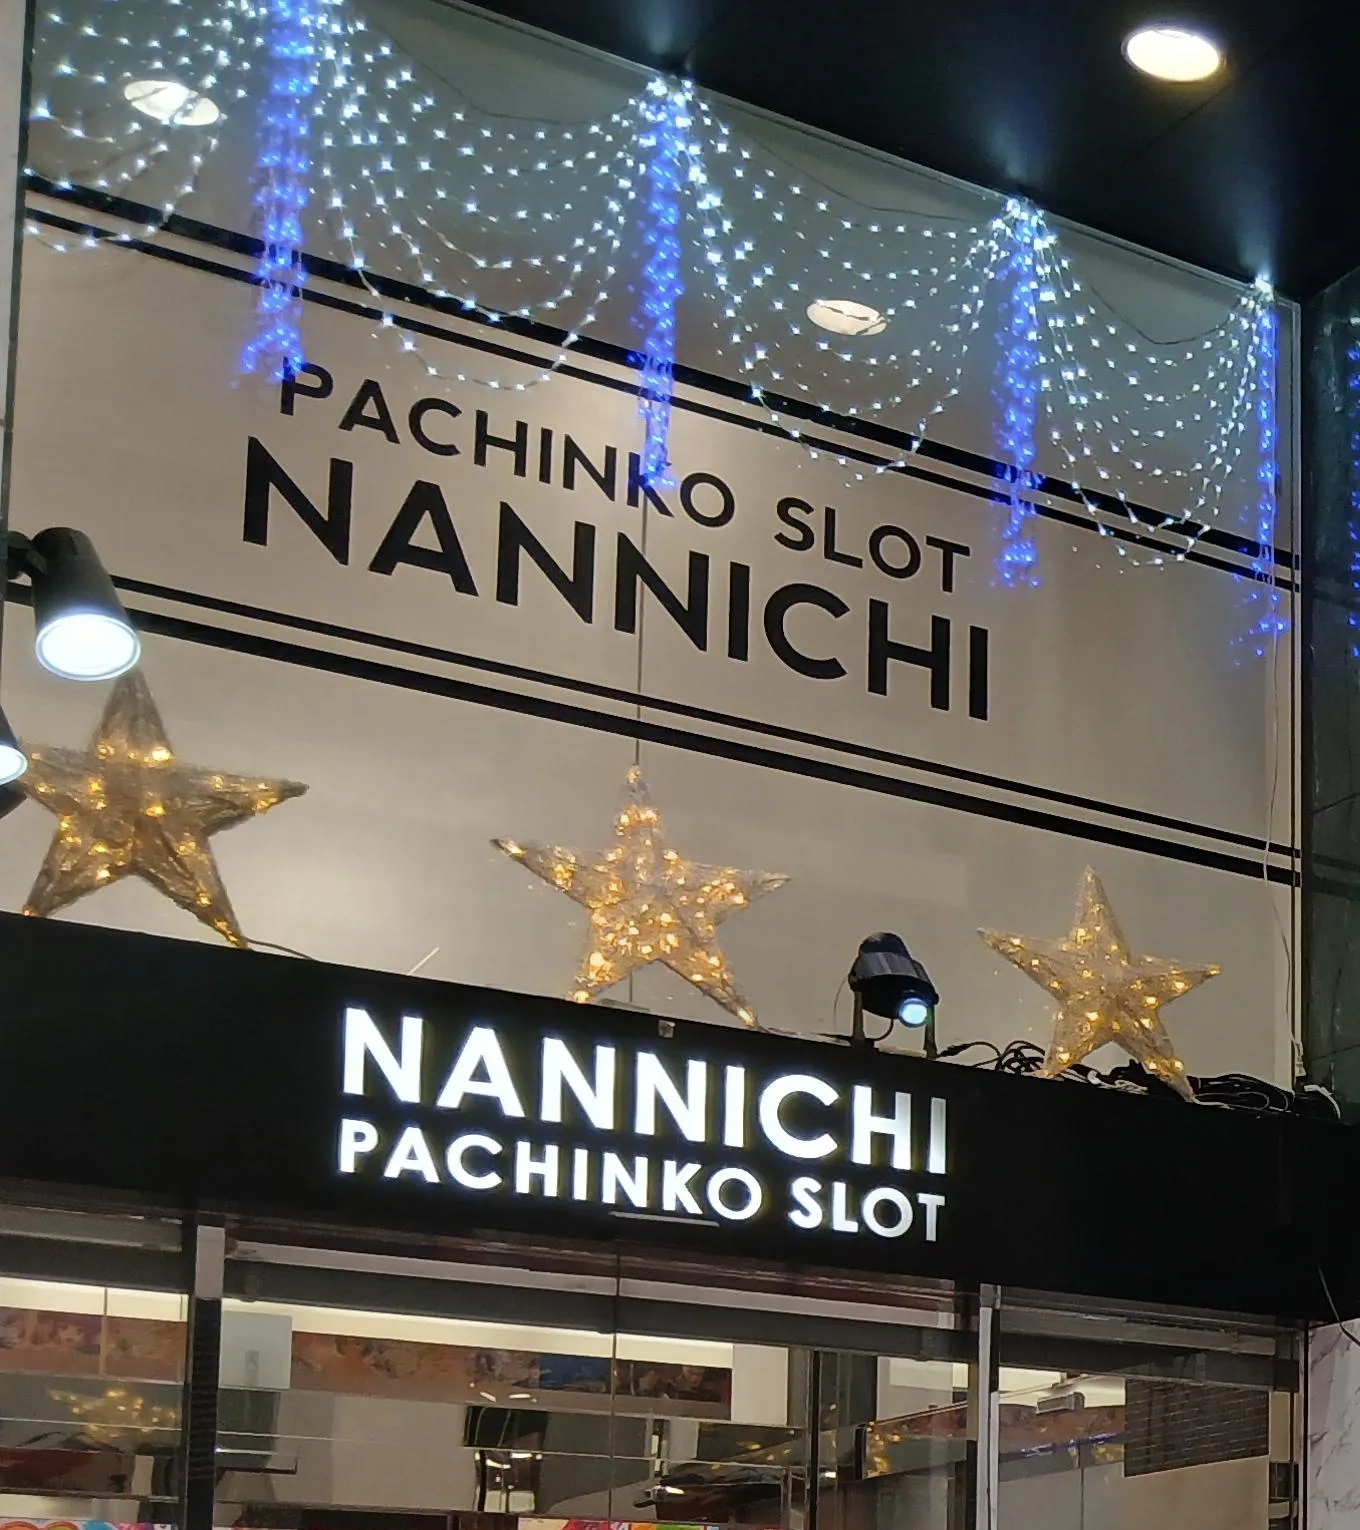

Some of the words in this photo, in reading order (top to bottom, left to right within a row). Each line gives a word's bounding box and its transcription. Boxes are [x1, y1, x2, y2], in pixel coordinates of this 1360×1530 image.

[242, 434, 988, 721] NANNICHI
[279, 358, 736, 530] PACHINKO
[775, 495, 971, 594] SLOT
[337, 1118, 763, 1222] PACHINKO
[787, 1176, 946, 1243] SLOT
[341, 1005, 948, 1176] NANNICHI
